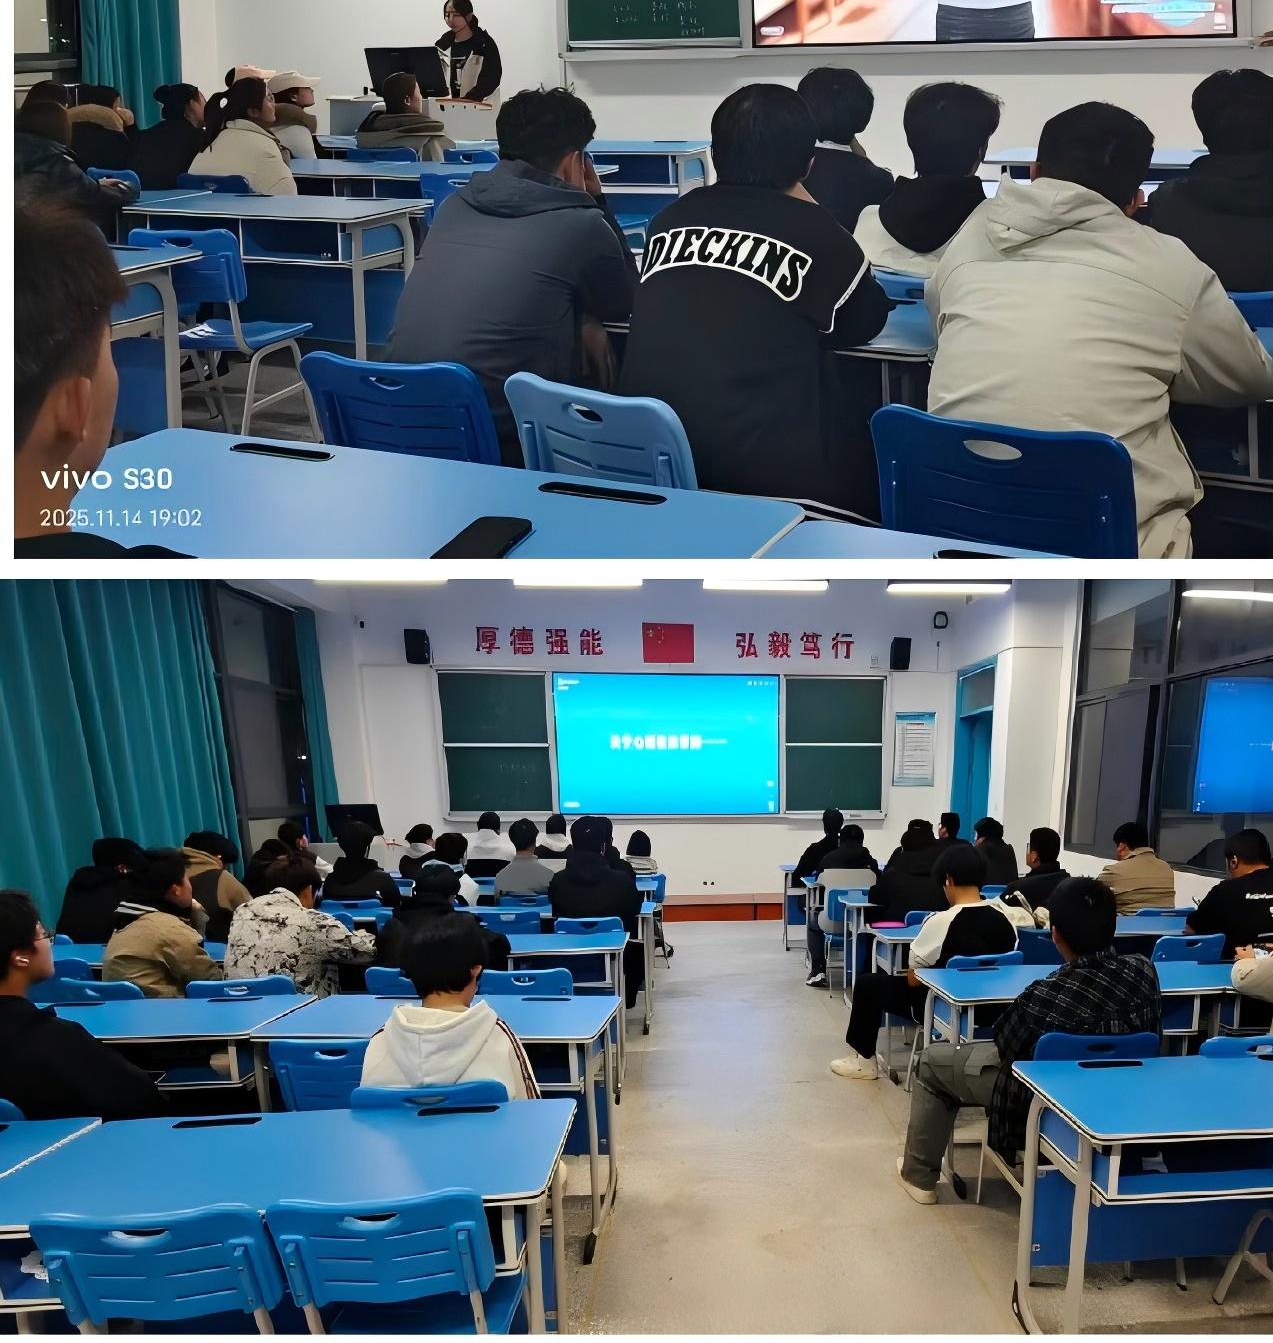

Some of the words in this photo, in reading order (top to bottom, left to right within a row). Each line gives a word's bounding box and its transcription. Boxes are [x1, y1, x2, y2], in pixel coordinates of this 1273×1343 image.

[475, 625, 604, 656] 厚德强能
[735, 630, 855, 660] 弘毅笃行
